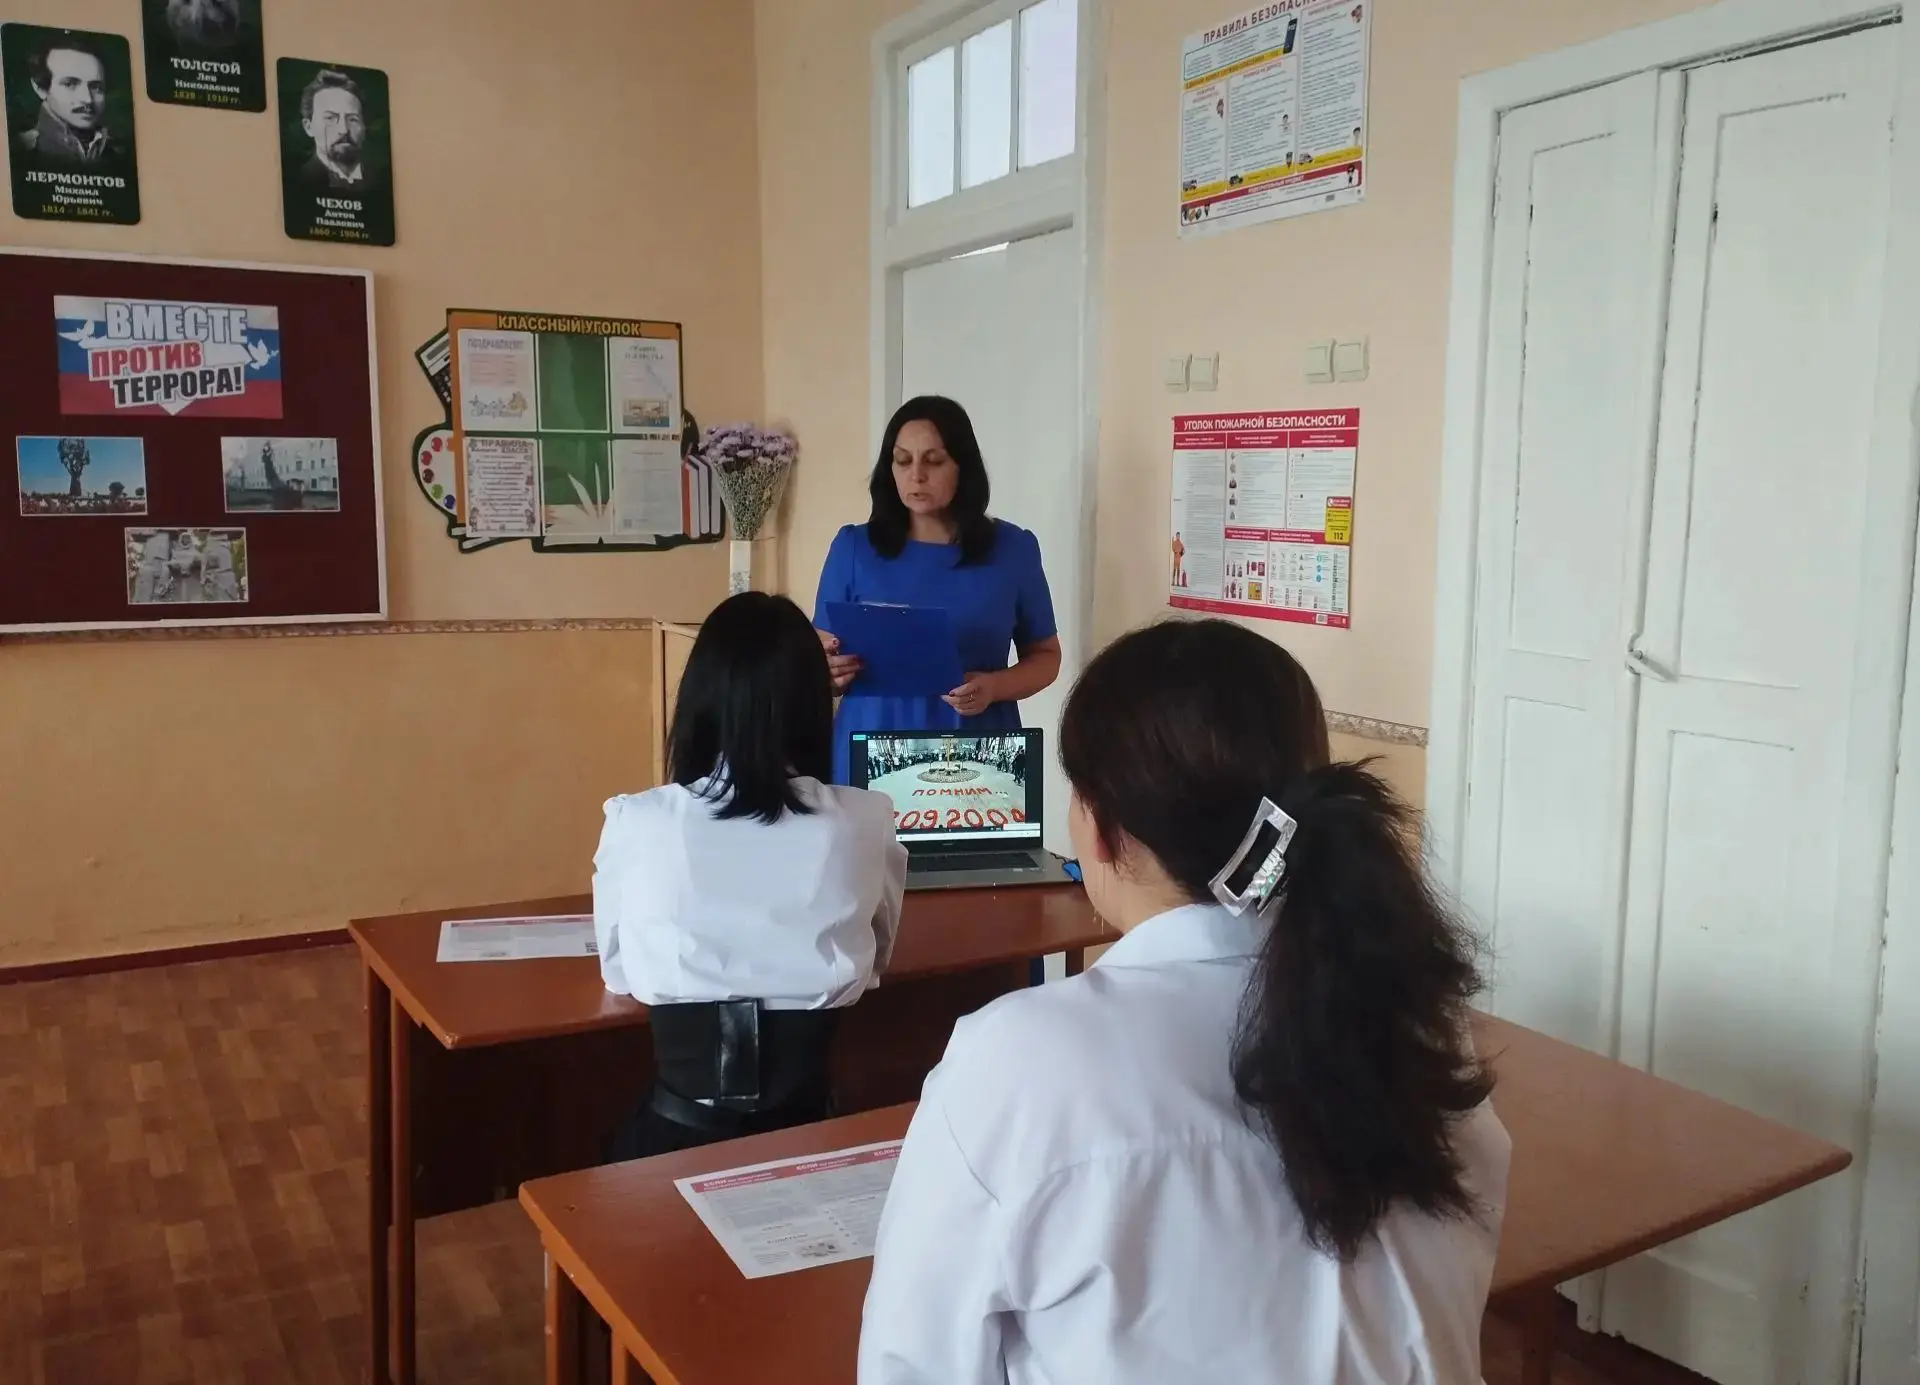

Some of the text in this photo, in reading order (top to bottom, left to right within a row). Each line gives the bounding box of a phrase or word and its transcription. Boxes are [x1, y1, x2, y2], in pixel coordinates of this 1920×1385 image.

[1203, 15, 1248, 44] ПРАВИЛА
[170, 57, 241, 75] ТОЛСТОЙ
[196, 73, 217, 82] Лев
[174, 79, 240, 93] Николаевич
[25, 171, 125, 188] ЛЕРМОНТОВ
[54, 185, 99, 196] Михаил
[52, 194, 103, 206] Юрьевич
[316, 197, 363, 211] ЧЕХОВ
[324, 209, 355, 219] Антон
[316, 217, 364, 229] Павлович
[104, 302, 248, 343] ВМЕСТЕ
[498, 315, 641, 336] КЛАССНЫЙ УГОЛОК
[91, 342, 202, 378] ПРОТИВ
[113, 366, 242, 405] ТЕРРОРА!
[1184, 415, 1346, 430] УГОЛОК ПОЖАРНОЙ БЕЗОПАСНОСТИ
[1334, 532, 1344, 541] 112
